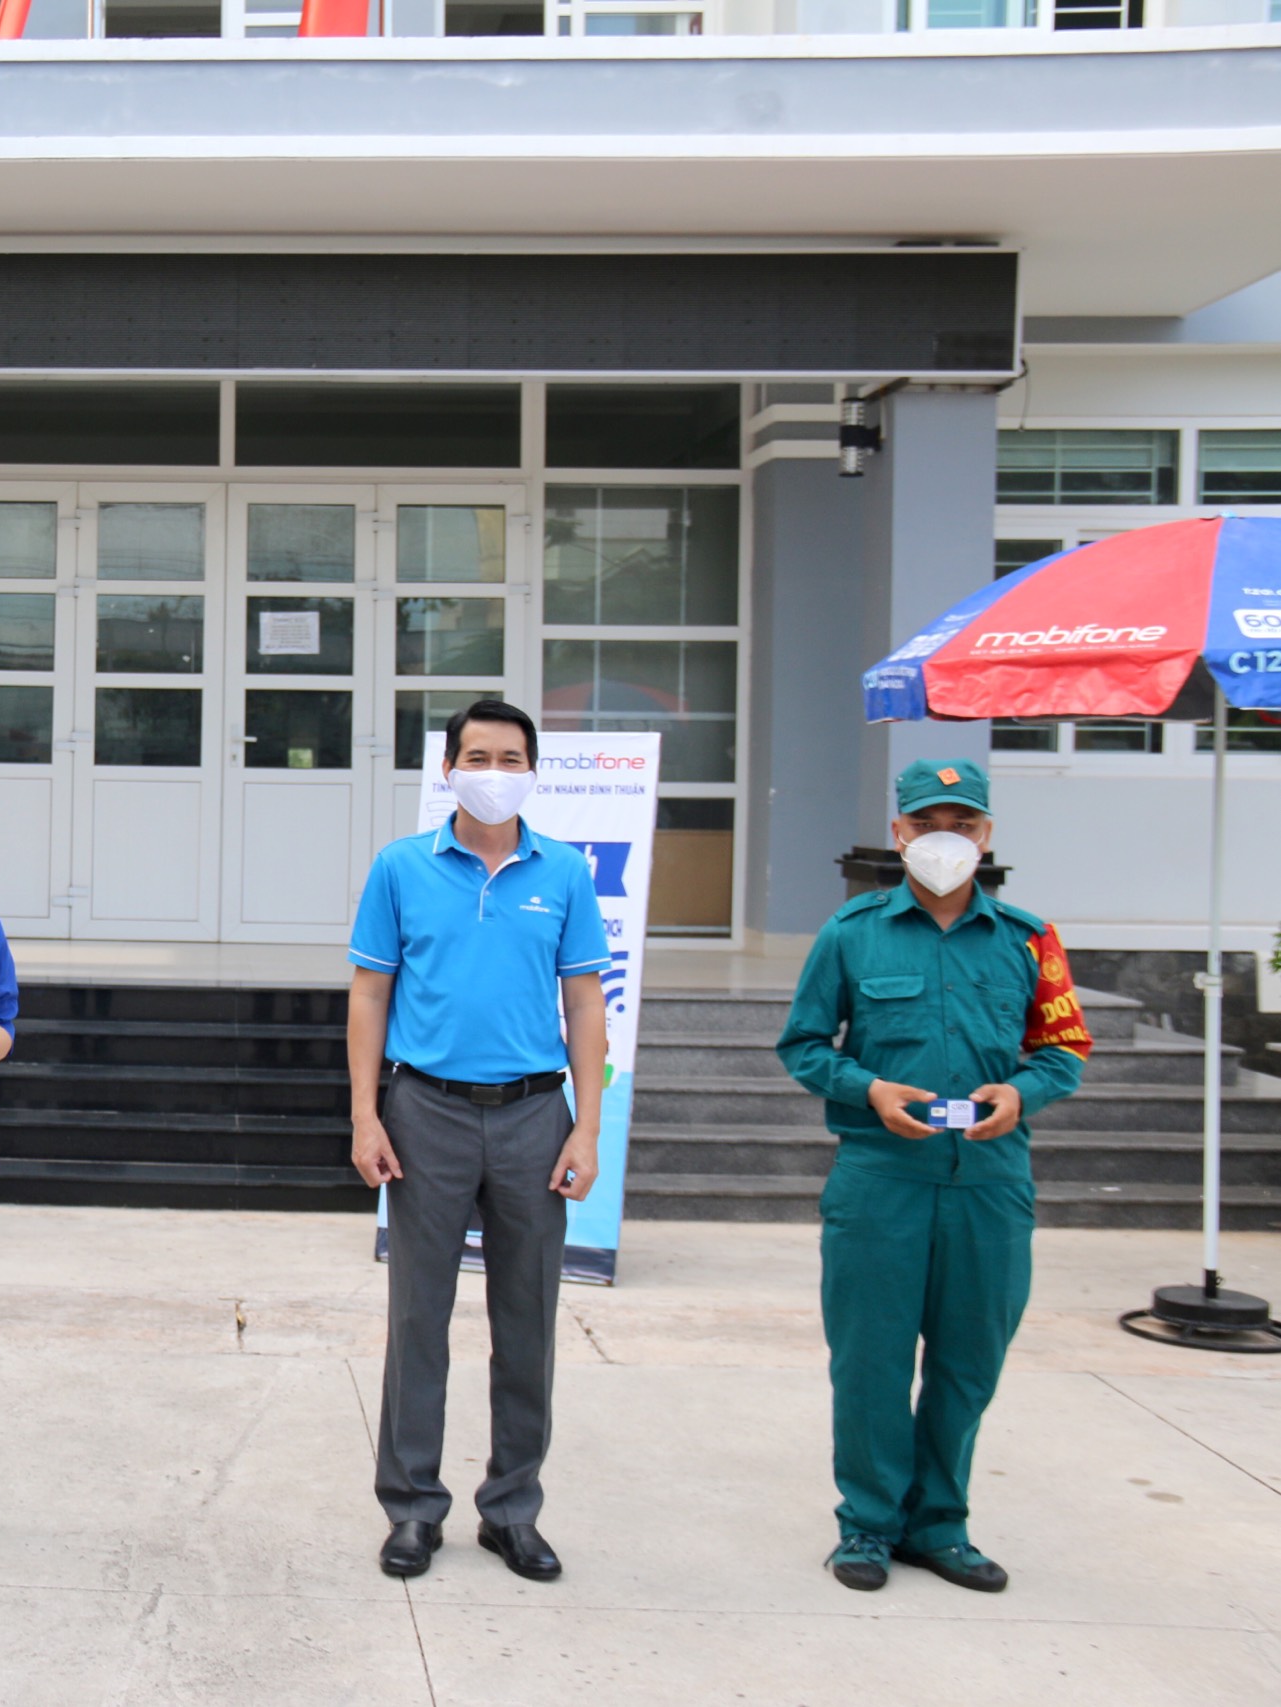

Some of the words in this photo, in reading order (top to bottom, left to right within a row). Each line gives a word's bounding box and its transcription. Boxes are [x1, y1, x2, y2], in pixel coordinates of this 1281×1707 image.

[975, 624, 1168, 648] mobifone
[540, 752, 646, 769] mobifone
[536, 784, 552, 794] CHI
[554, 782, 587, 794] NHÁNH
